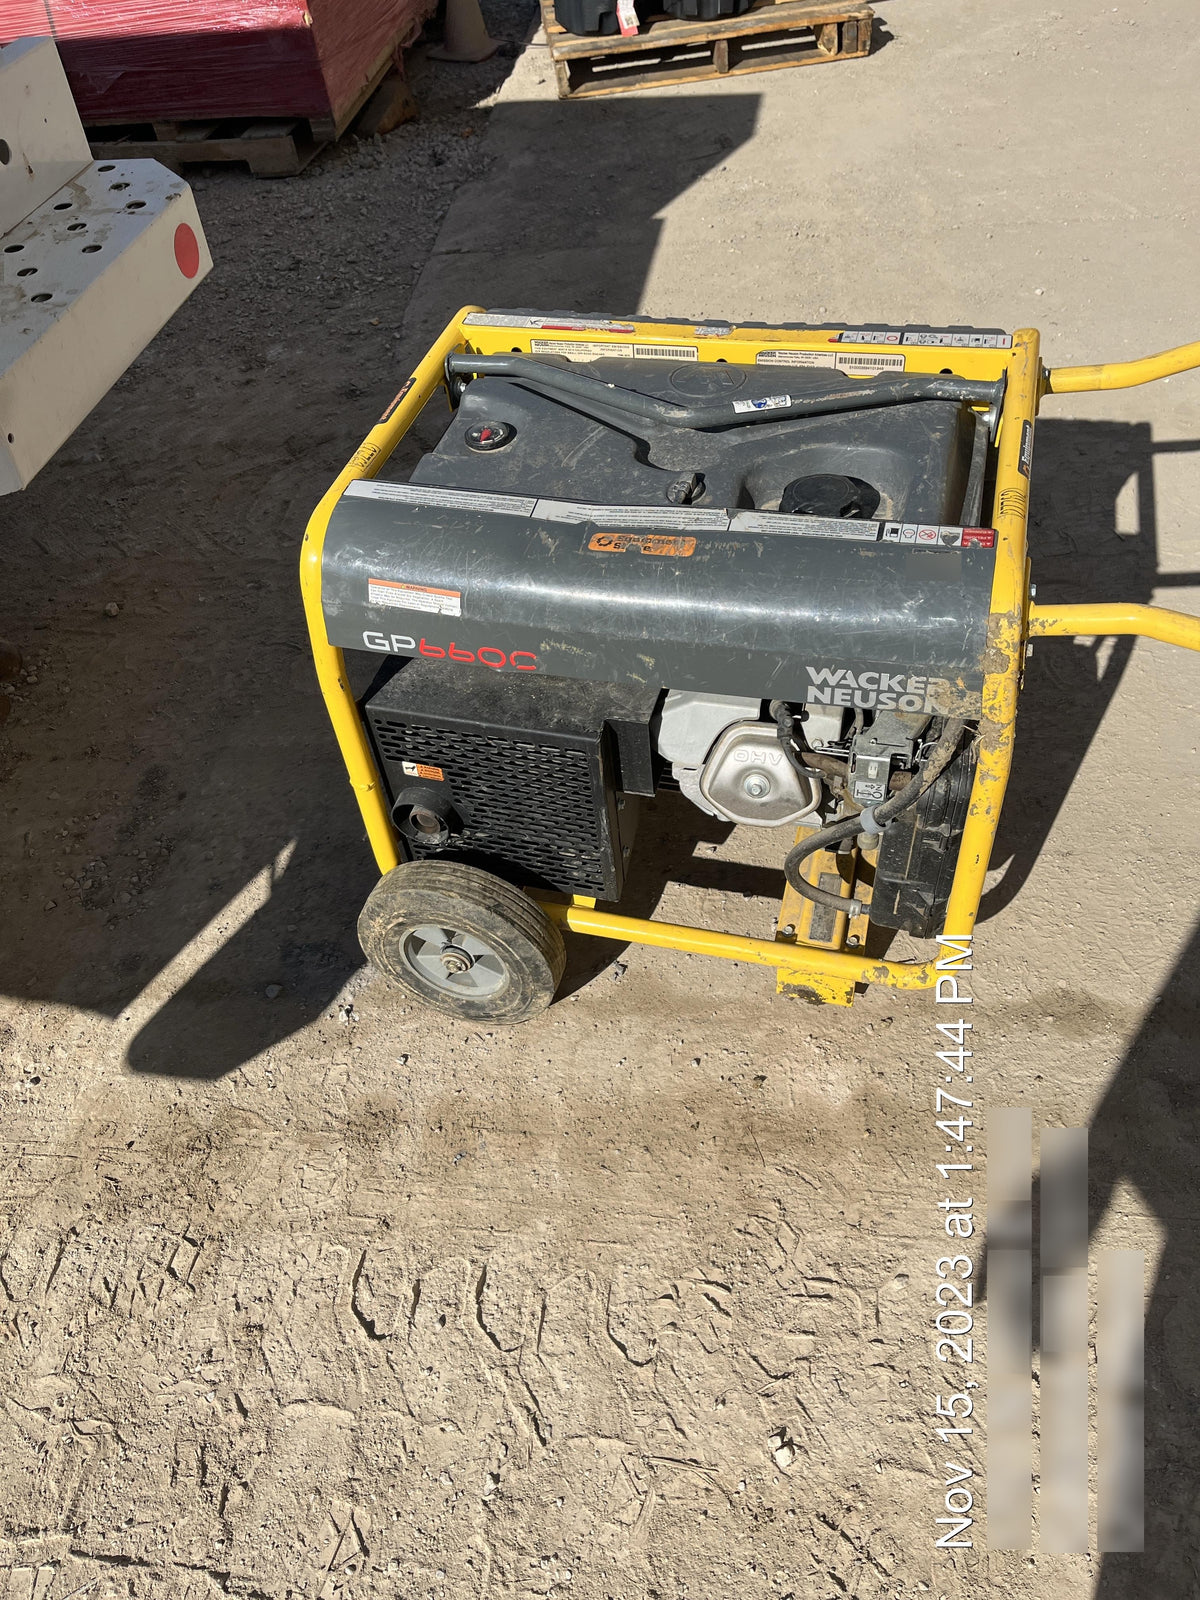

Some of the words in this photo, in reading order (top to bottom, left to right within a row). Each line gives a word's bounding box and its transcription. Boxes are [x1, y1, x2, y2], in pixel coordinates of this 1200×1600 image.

[805, 666, 950, 695] WACKER
[806, 685, 950, 715] NEUSON
[733, 749, 783, 766] OHV
